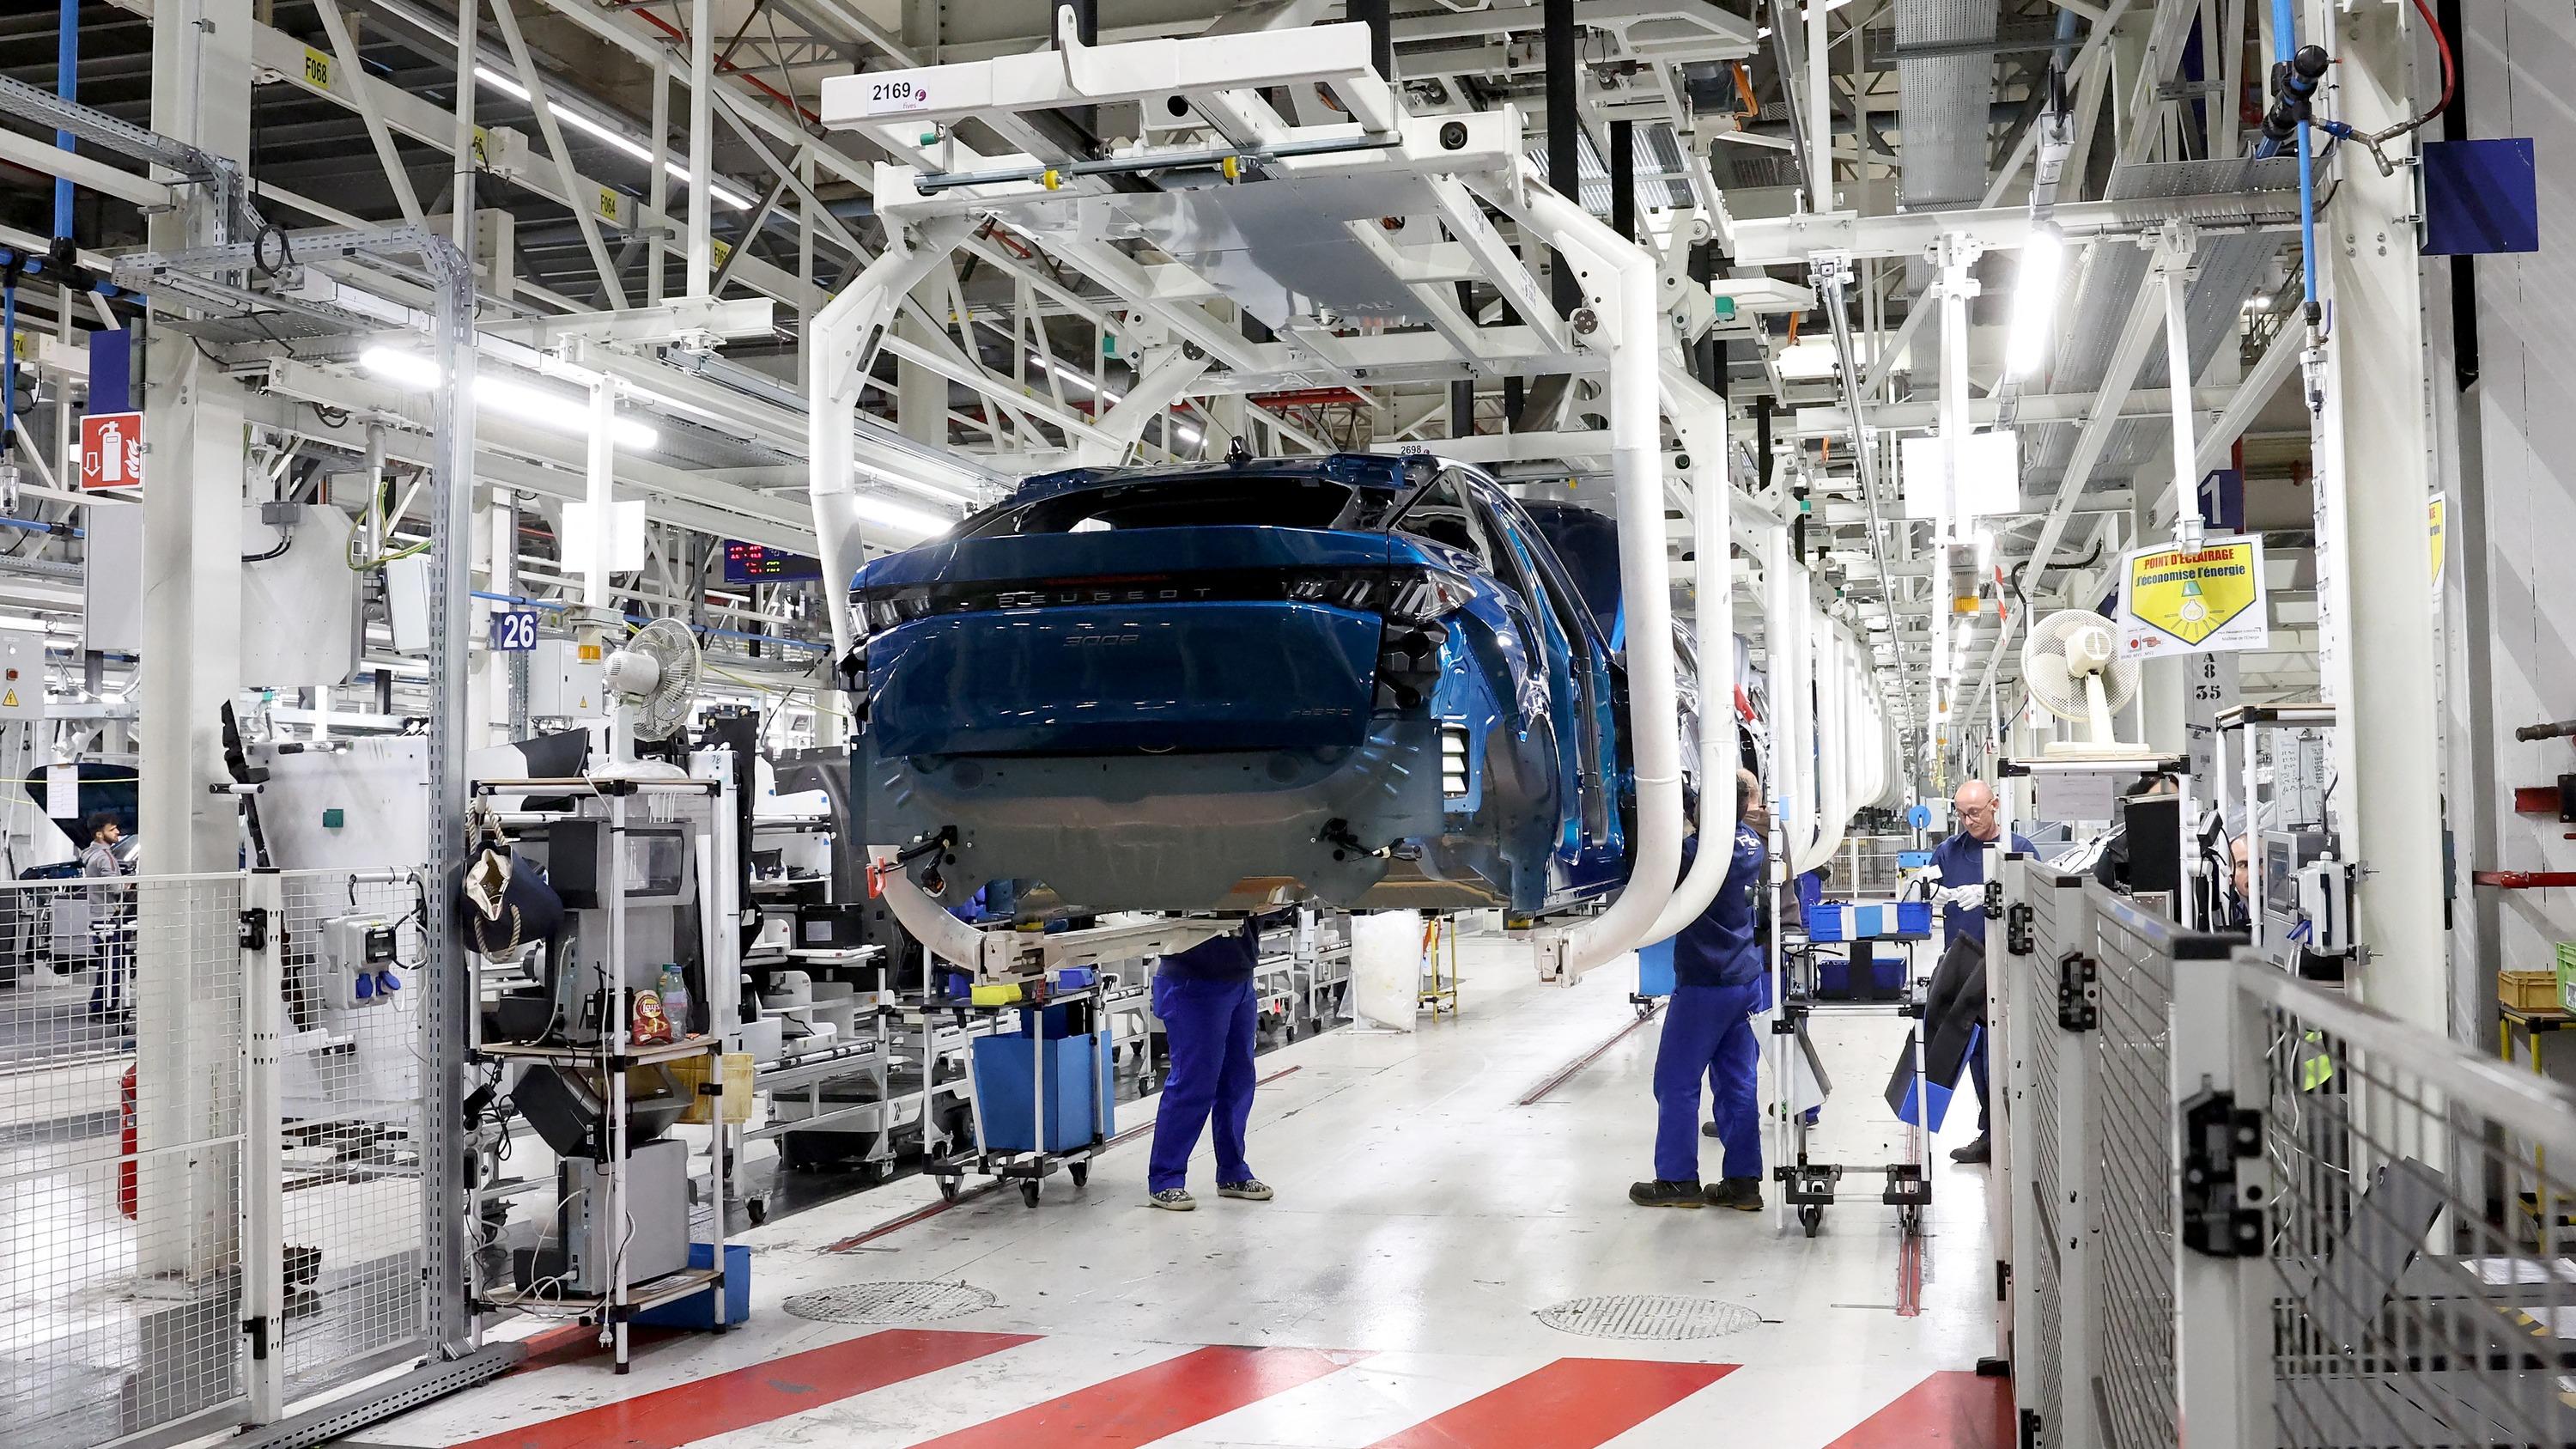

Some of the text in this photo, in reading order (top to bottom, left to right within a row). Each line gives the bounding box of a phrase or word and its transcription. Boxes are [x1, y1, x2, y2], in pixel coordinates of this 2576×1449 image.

[306, 56, 327, 83] F068
[872, 82, 911, 100] 2169
[601, 193, 616, 214] F064
[1400, 445, 1422, 454] 2698
[2144, 555, 2169, 570] POINT
[2197, 563, 2245, 579] l'énergie
[999, 588, 1211, 606] PEUGEOT
[503, 614, 534, 648] 26
[2203, 653, 2215, 663] A
[2204, 664, 2215, 679] 8
[2196, 685, 2221, 700] 35
